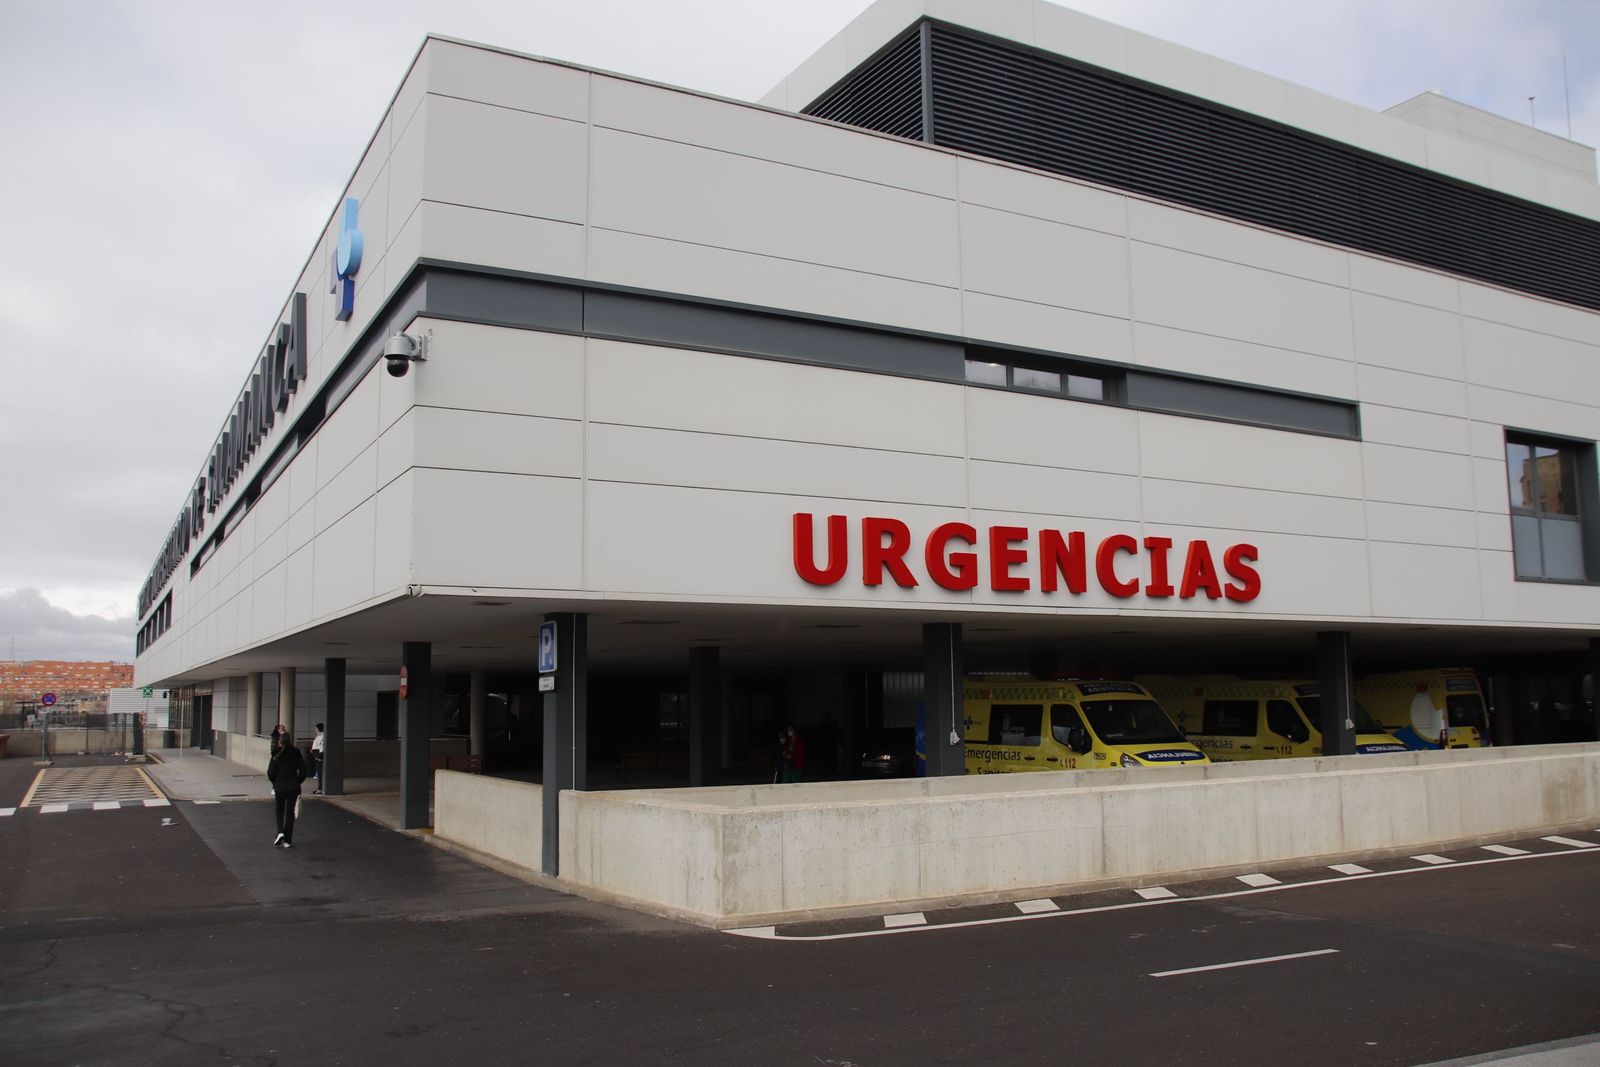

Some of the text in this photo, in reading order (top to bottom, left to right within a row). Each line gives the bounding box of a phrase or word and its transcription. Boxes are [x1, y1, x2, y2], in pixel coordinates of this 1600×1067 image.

[207, 292, 307, 513] SALAMANCA
[793, 513, 1261, 602] URGENCIAS
[542, 628, 551, 667] P
[1064, 758, 1076, 769] 112
